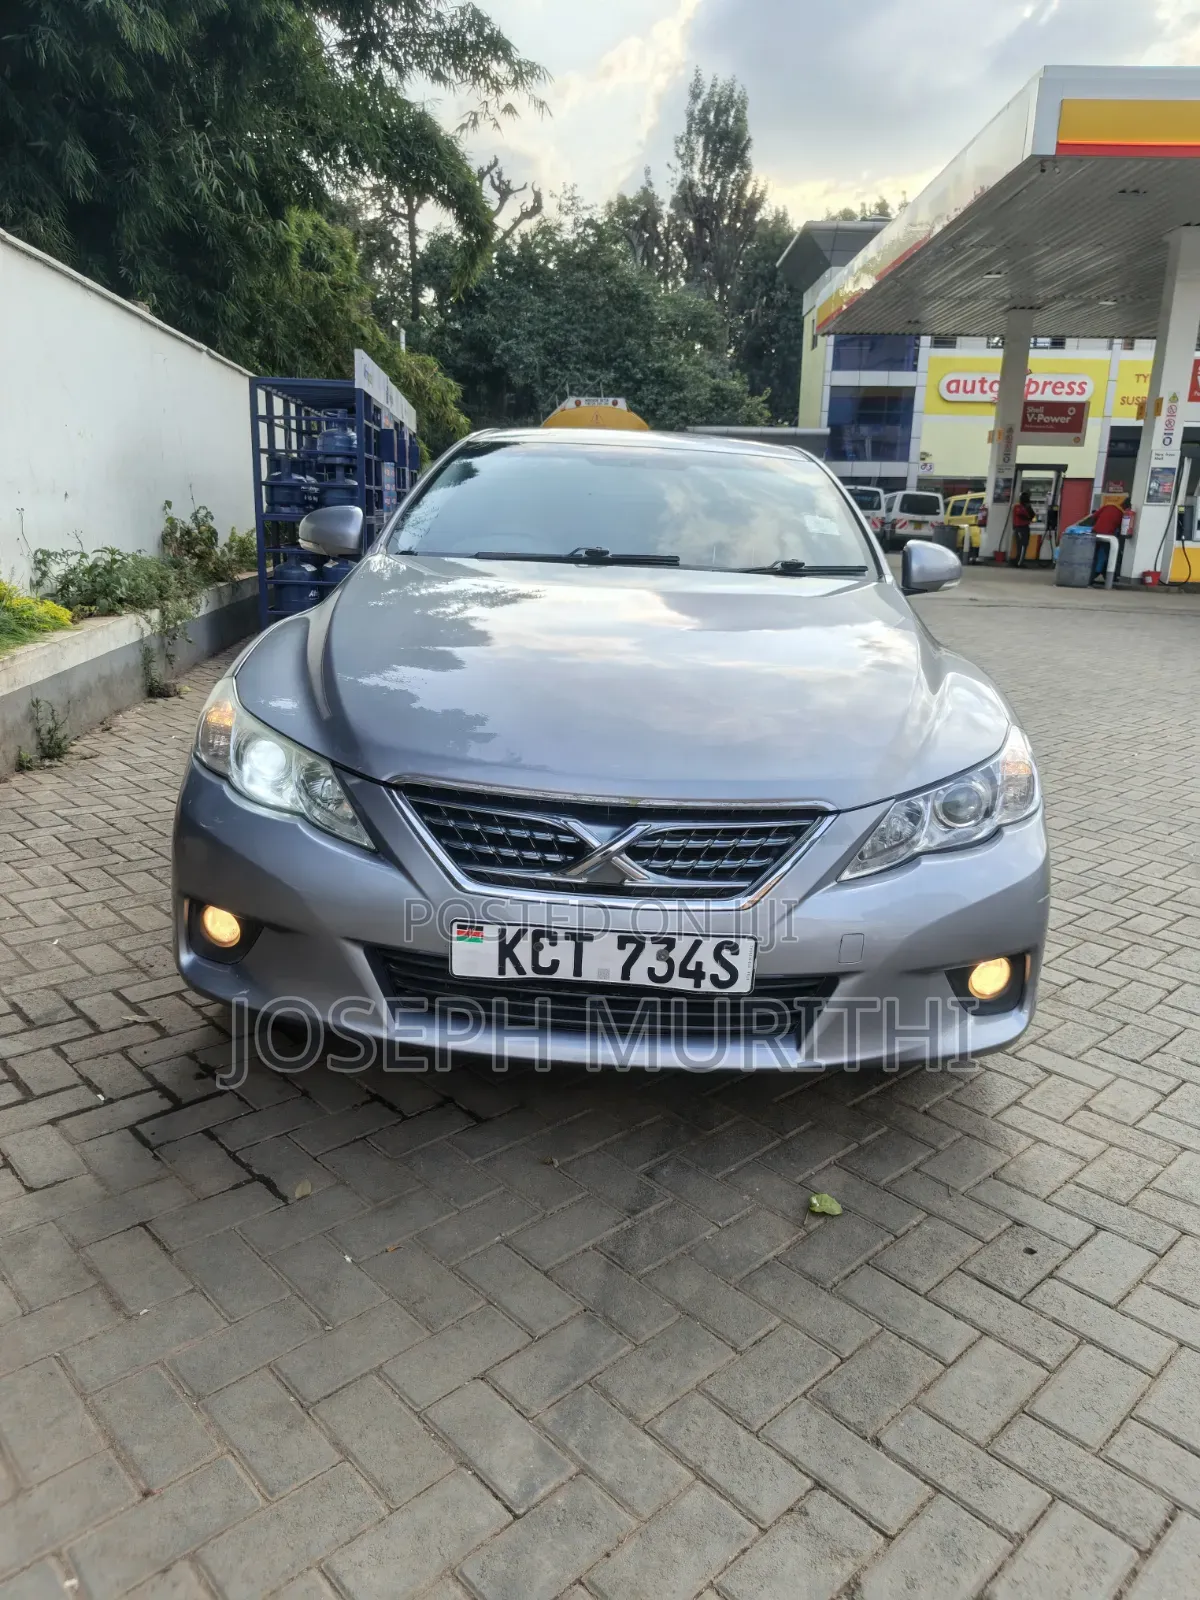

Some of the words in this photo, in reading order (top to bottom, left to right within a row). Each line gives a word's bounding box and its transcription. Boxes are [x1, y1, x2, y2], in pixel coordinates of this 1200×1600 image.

[1026, 406, 1045, 414] Shell
[1026, 413, 1072, 424] V-Power
[498, 928, 594, 977] KCT
[617, 934, 740, 989] 734S
